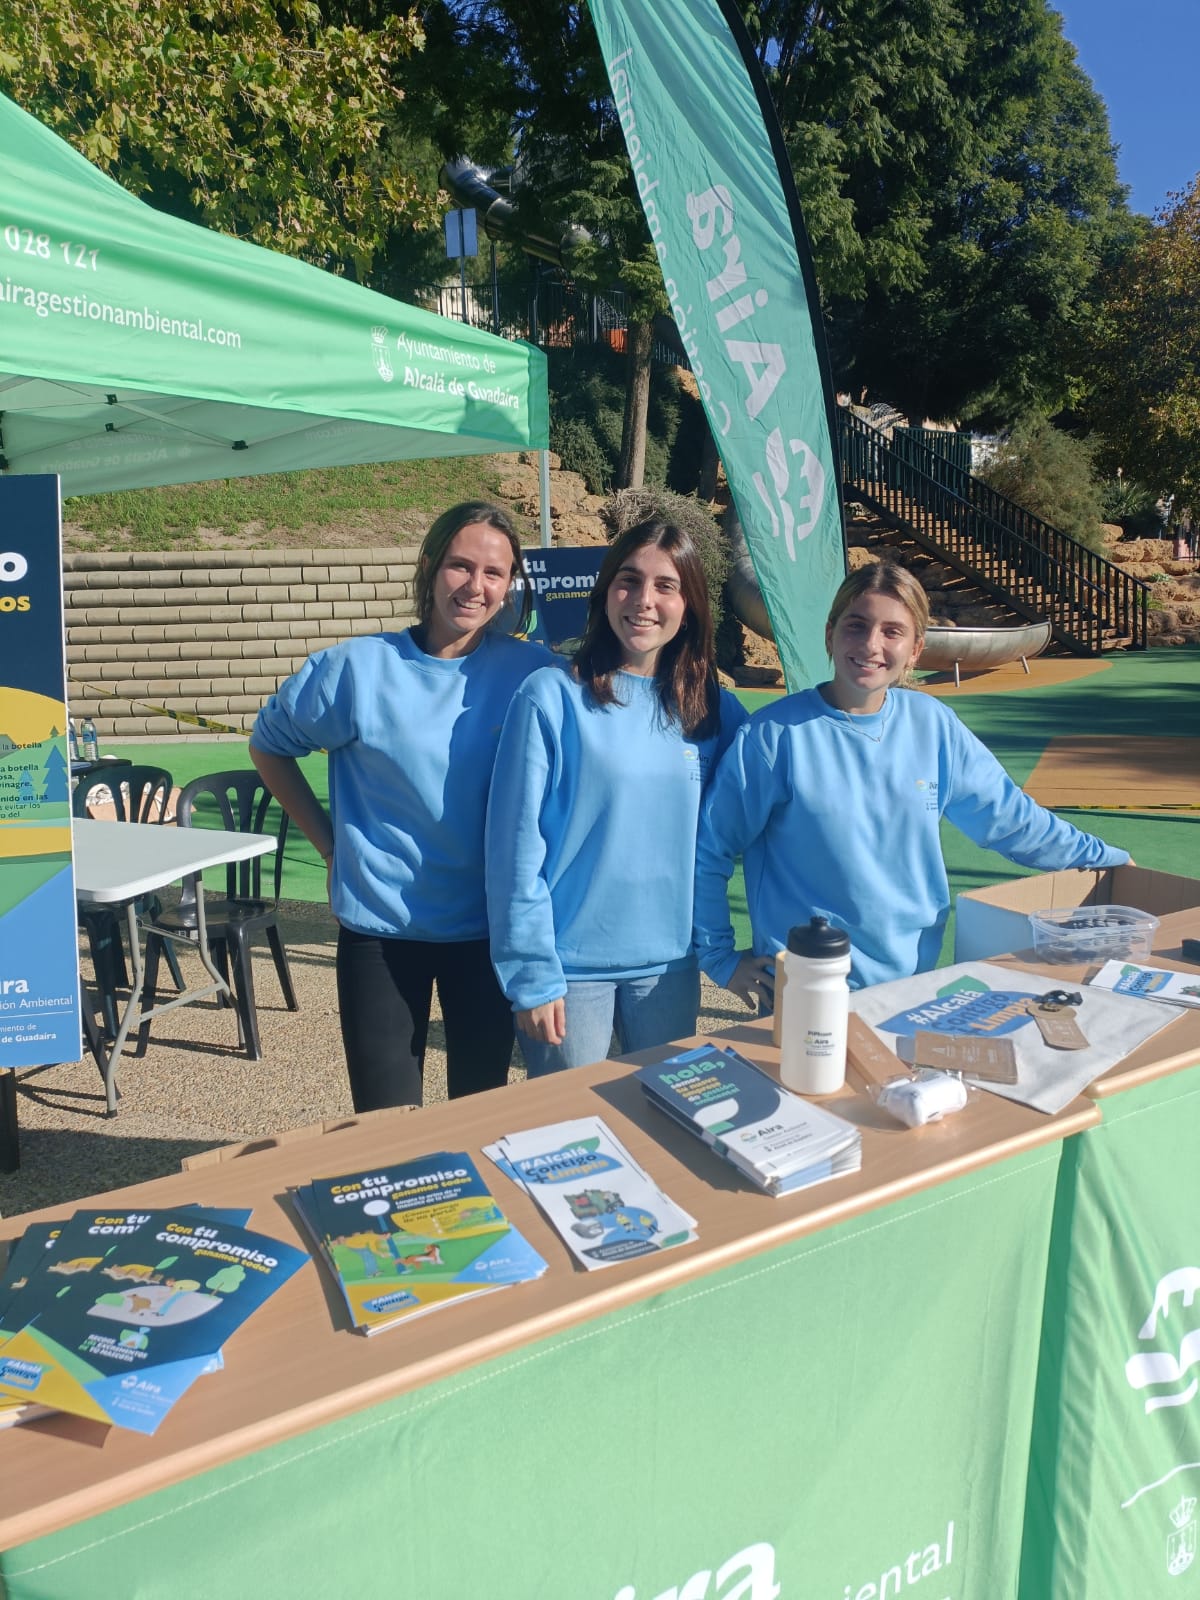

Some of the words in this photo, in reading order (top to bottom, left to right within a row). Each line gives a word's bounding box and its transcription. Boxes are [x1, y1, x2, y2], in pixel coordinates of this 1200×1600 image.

[4, 224, 51, 260] 028
[60, 240, 100, 272] 121
[397, 332, 481, 372] Ayuntamiento
[483, 354, 496, 375] de
[403, 366, 446, 394] Alcalá
[448, 382, 466, 398] de
[523, 557, 547, 574] tu
[11, 742, 42, 750] botella
[7, 764, 39, 772] botella
[19, 995, 73, 1008] Ambiental
[906, 989, 985, 1025] #Alcalá
[931, 994, 1010, 1032] Contigo
[658, 1061, 726, 1086] hola,
[520, 1145, 589, 1171] #Alcalá
[525, 1154, 597, 1177] Contigo
[331, 1183, 361, 1195] Con
[361, 1175, 389, 1188] tu
[333, 1168, 468, 1204] compromiso
[391, 1183, 439, 1200] ganamos
[441, 1176, 472, 1188] todos
[88, 1225, 140, 1235] com
[94, 1217, 125, 1225] Con
[165, 1223, 193, 1234] Con
[194, 1225, 219, 1239] tu
[155, 1230, 279, 1268] compromiso
[241, 1259, 272, 1275] todos
